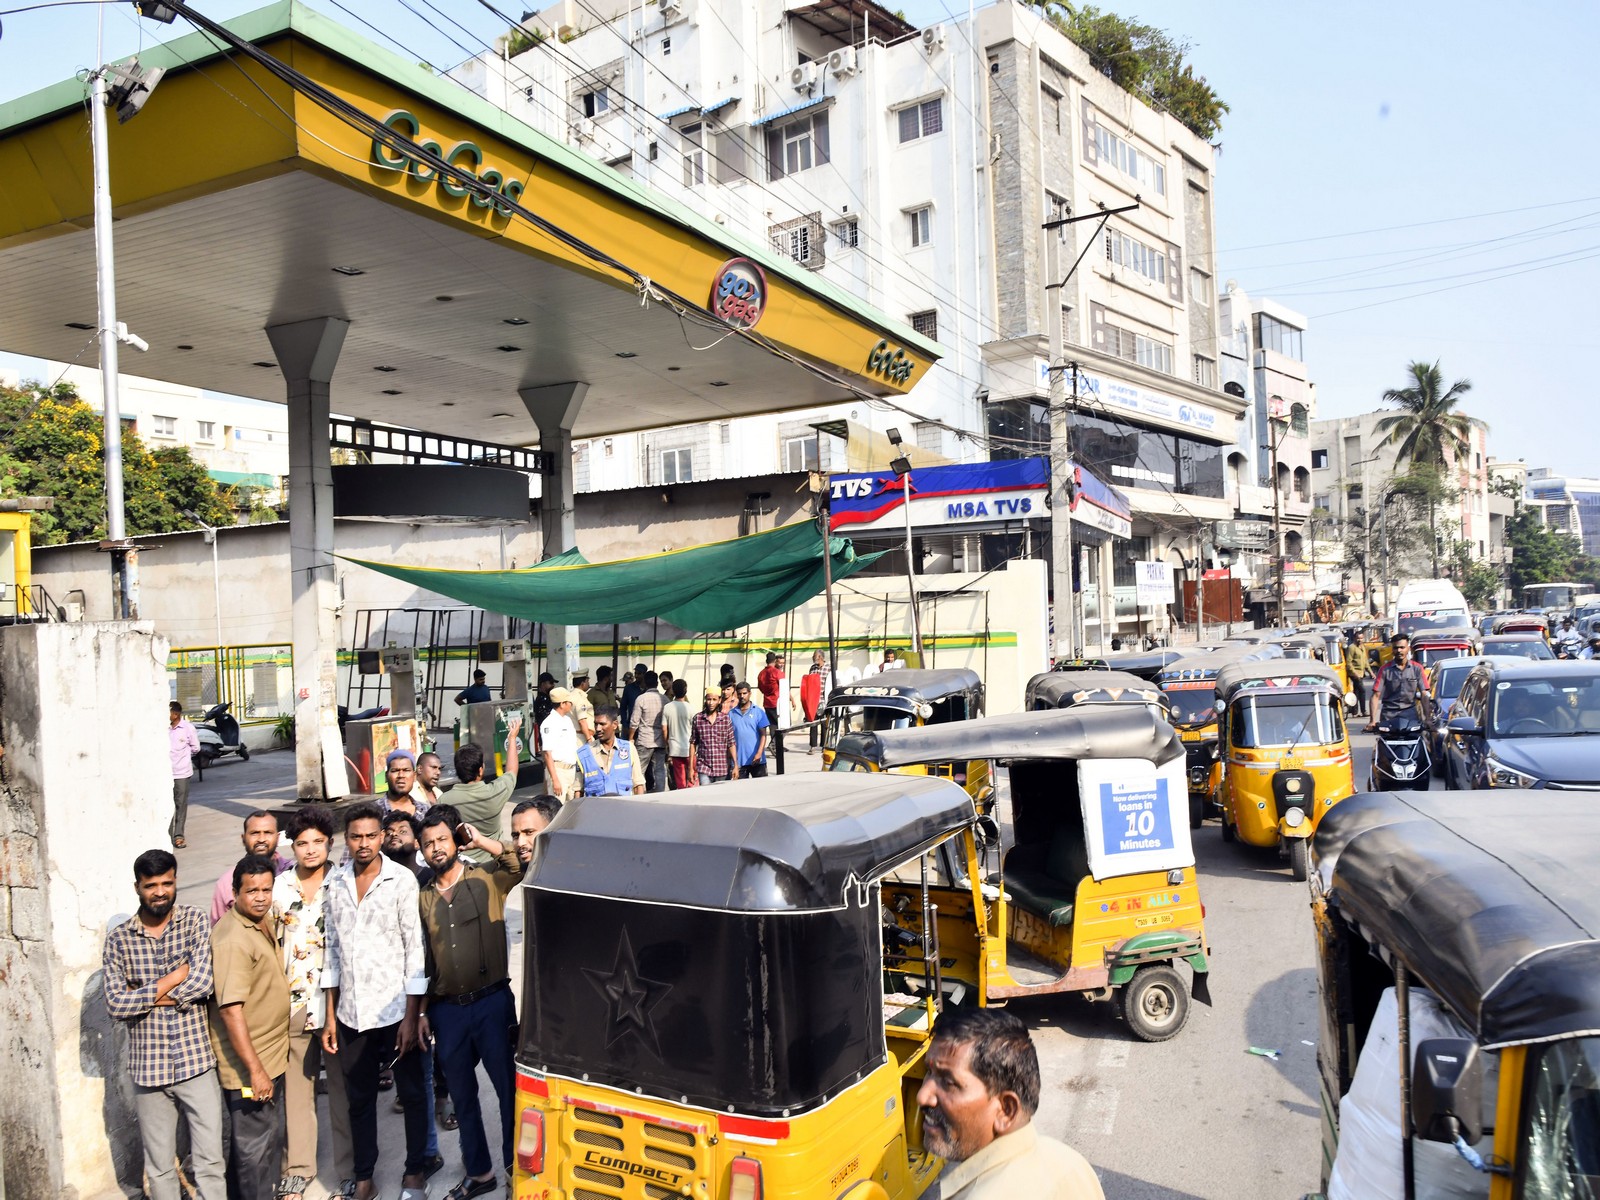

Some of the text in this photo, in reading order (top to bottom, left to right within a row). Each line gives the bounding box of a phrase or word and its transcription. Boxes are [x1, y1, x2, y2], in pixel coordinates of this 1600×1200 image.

[719, 272, 749, 297] go
[720, 294, 758, 323] gas
[831, 478, 872, 499] TVS
[948, 498, 1032, 518] MSA TVS
[1119, 801, 1153, 812] loans in
[1128, 793, 1157, 801] delivering
[1124, 810, 1155, 837] 10
[1120, 838, 1161, 851] Minutes
